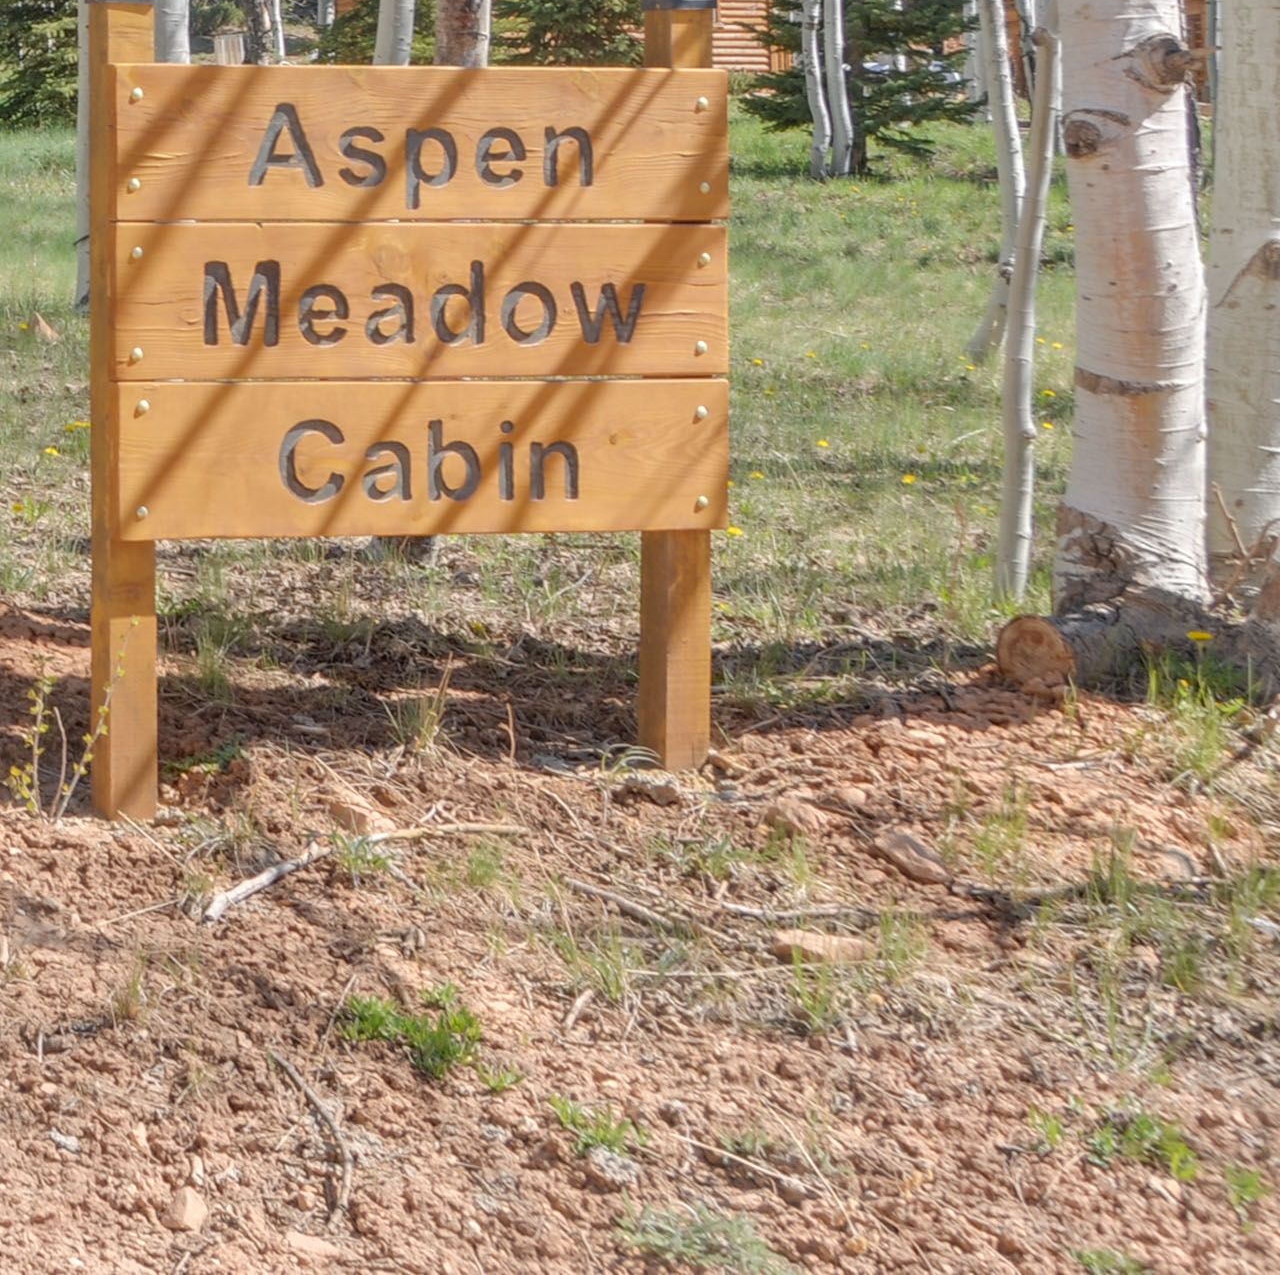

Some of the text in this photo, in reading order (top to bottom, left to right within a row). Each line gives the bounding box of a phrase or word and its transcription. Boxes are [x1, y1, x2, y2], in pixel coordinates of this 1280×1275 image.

[247, 102, 593, 210] Aspen
[202, 259, 646, 348] Meadow
[278, 419, 579, 504] Cabin
